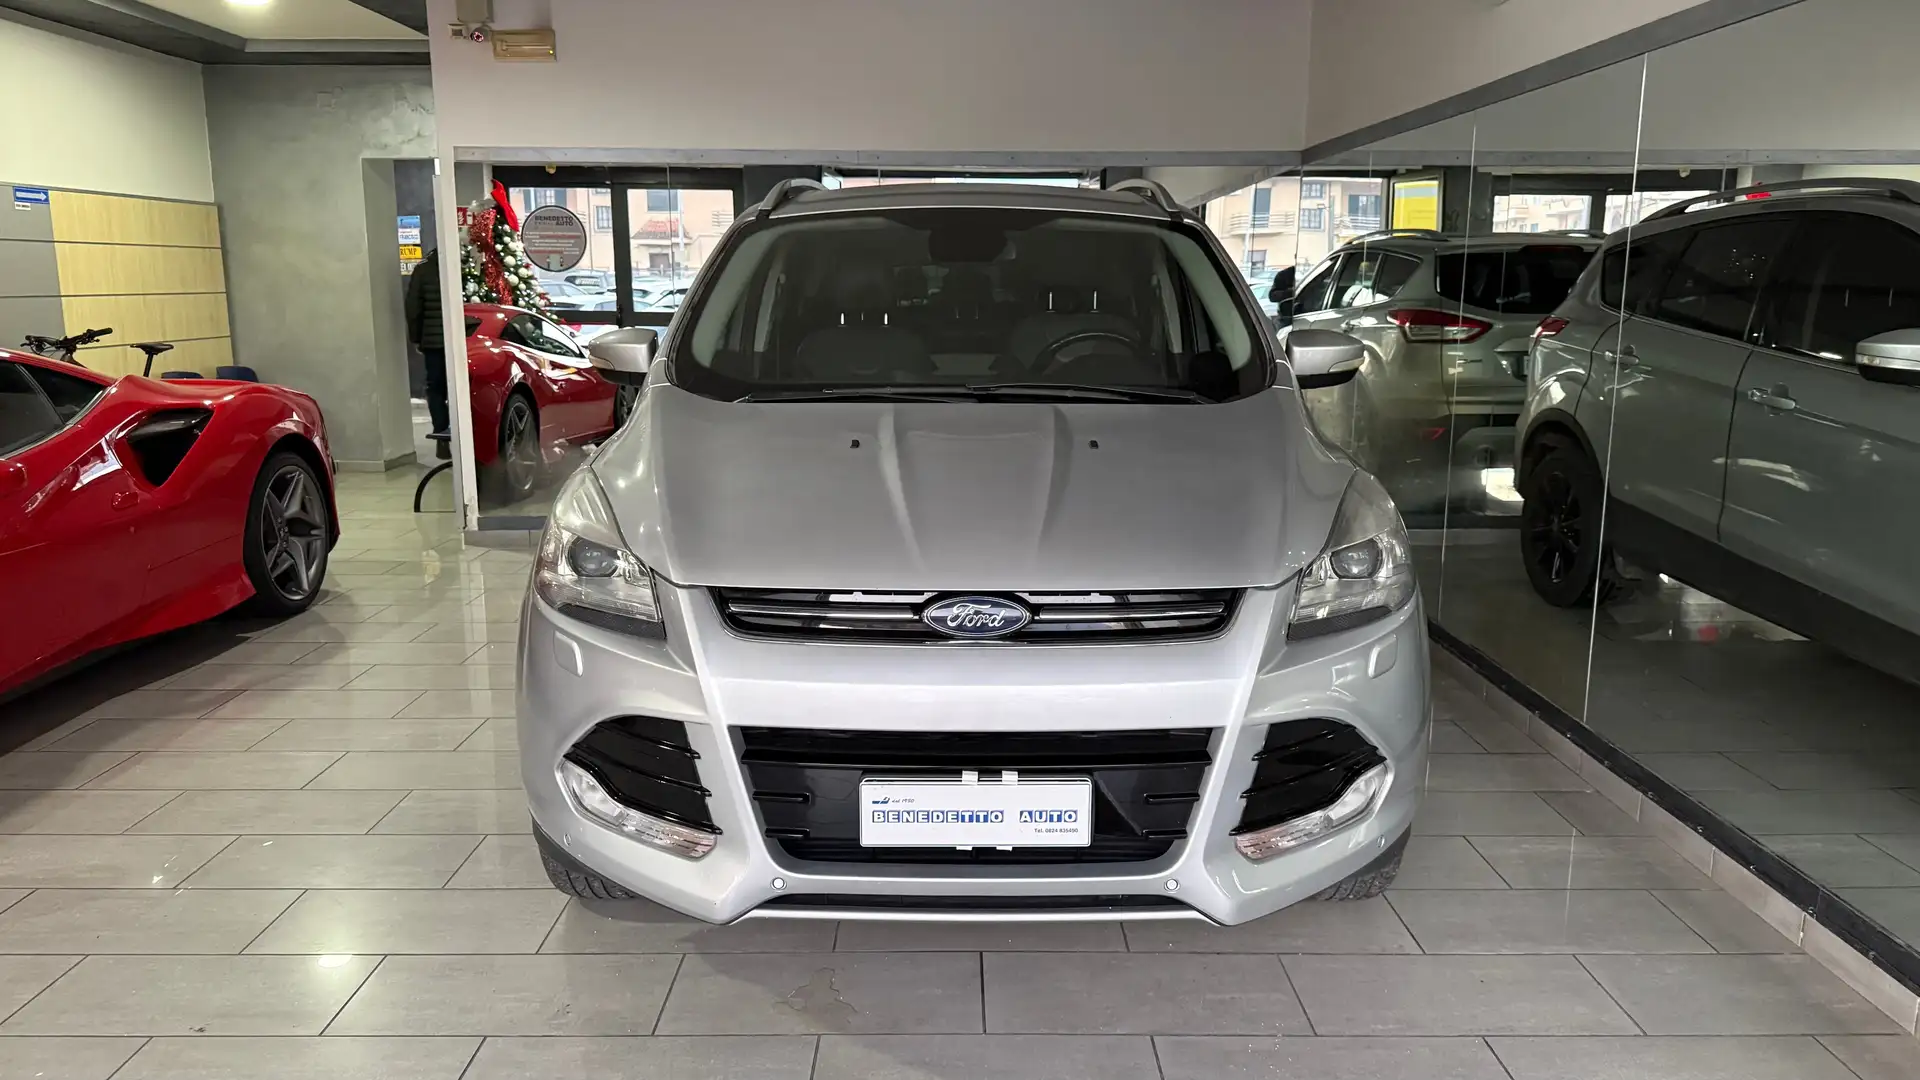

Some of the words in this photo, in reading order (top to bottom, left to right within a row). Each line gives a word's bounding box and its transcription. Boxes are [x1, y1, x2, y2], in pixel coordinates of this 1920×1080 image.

[946, 602, 1006, 627] Ford
[872, 809, 1004, 824] BENEDETTO
[1019, 809, 1078, 824] AUTO
